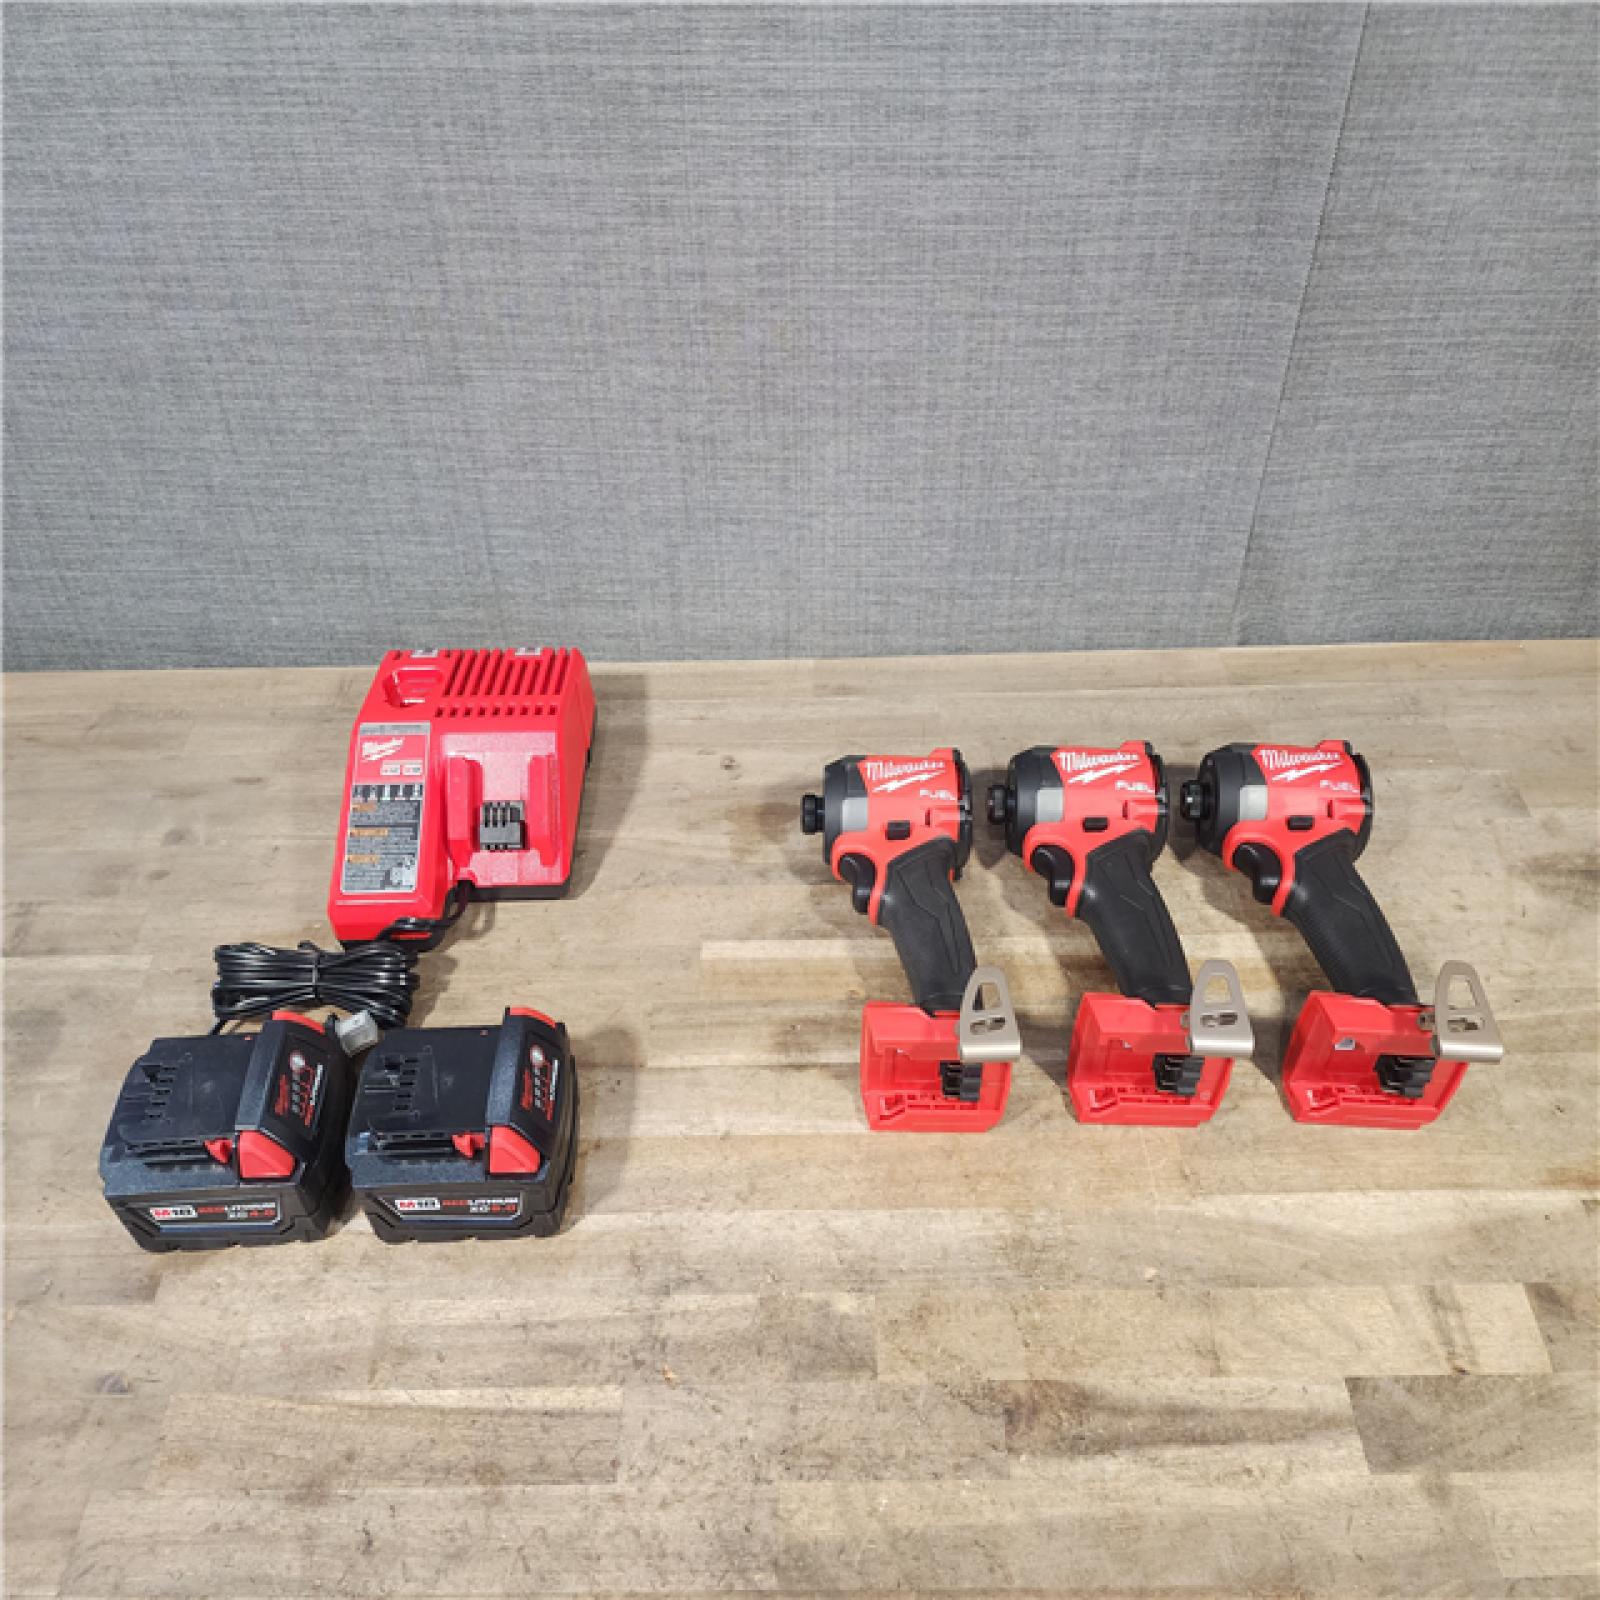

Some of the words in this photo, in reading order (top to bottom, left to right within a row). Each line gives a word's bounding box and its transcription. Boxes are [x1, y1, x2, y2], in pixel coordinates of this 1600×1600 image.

[1058, 752, 1138, 773] Milwaukee
[1258, 749, 1341, 770] Milwaukee
[865, 760, 945, 781] Milwaukee
